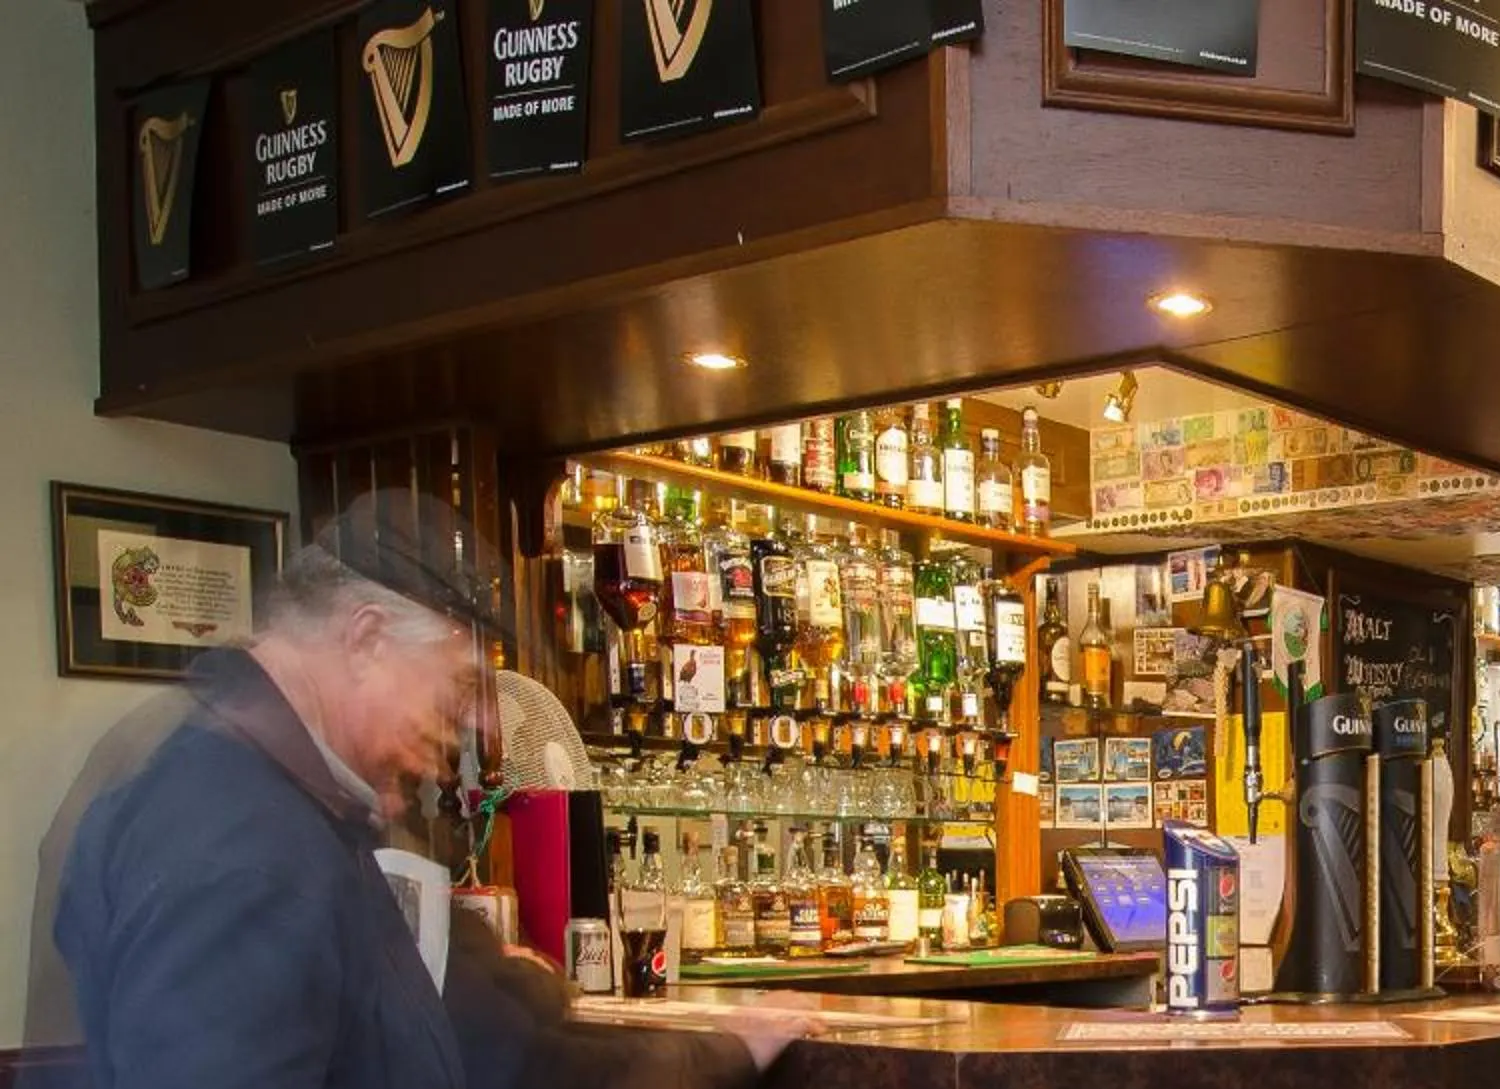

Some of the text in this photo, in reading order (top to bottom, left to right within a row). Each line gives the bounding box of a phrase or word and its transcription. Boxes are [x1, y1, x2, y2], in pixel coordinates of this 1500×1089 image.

[493, 21, 579, 60] GUINNESS
[1430, 7, 1452, 26] OF
[1455, 15, 1500, 47] MORE
[505, 55, 564, 88] RUGBY
[493, 96, 575, 121] MADE OF MORE
[255, 119, 327, 163] GUINNESS
[266, 151, 316, 185] RUGBY
[1168, 869, 1198, 1008] PEPSI
